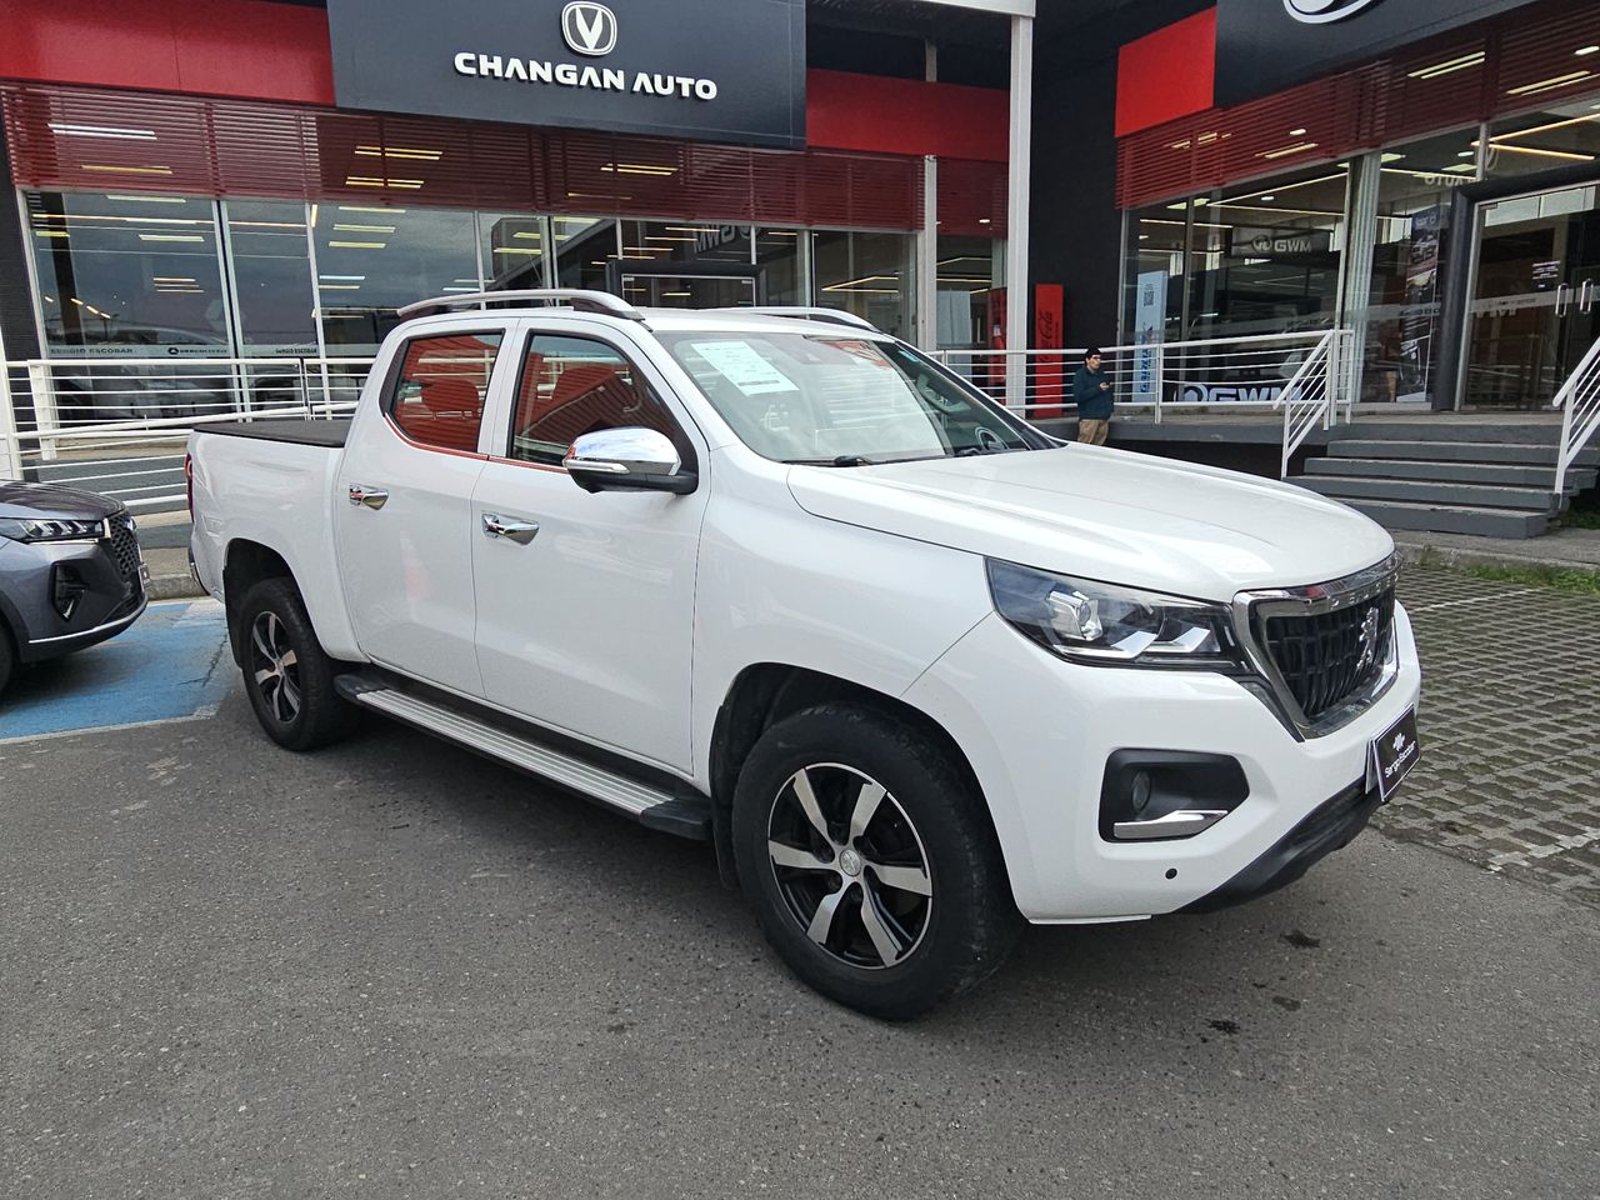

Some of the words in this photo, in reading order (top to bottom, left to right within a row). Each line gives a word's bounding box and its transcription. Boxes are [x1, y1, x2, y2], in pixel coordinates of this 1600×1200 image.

[454, 52, 624, 91] CHANGAN
[632, 72, 718, 100] AUTO
[1274, 239, 1313, 253] GWM
